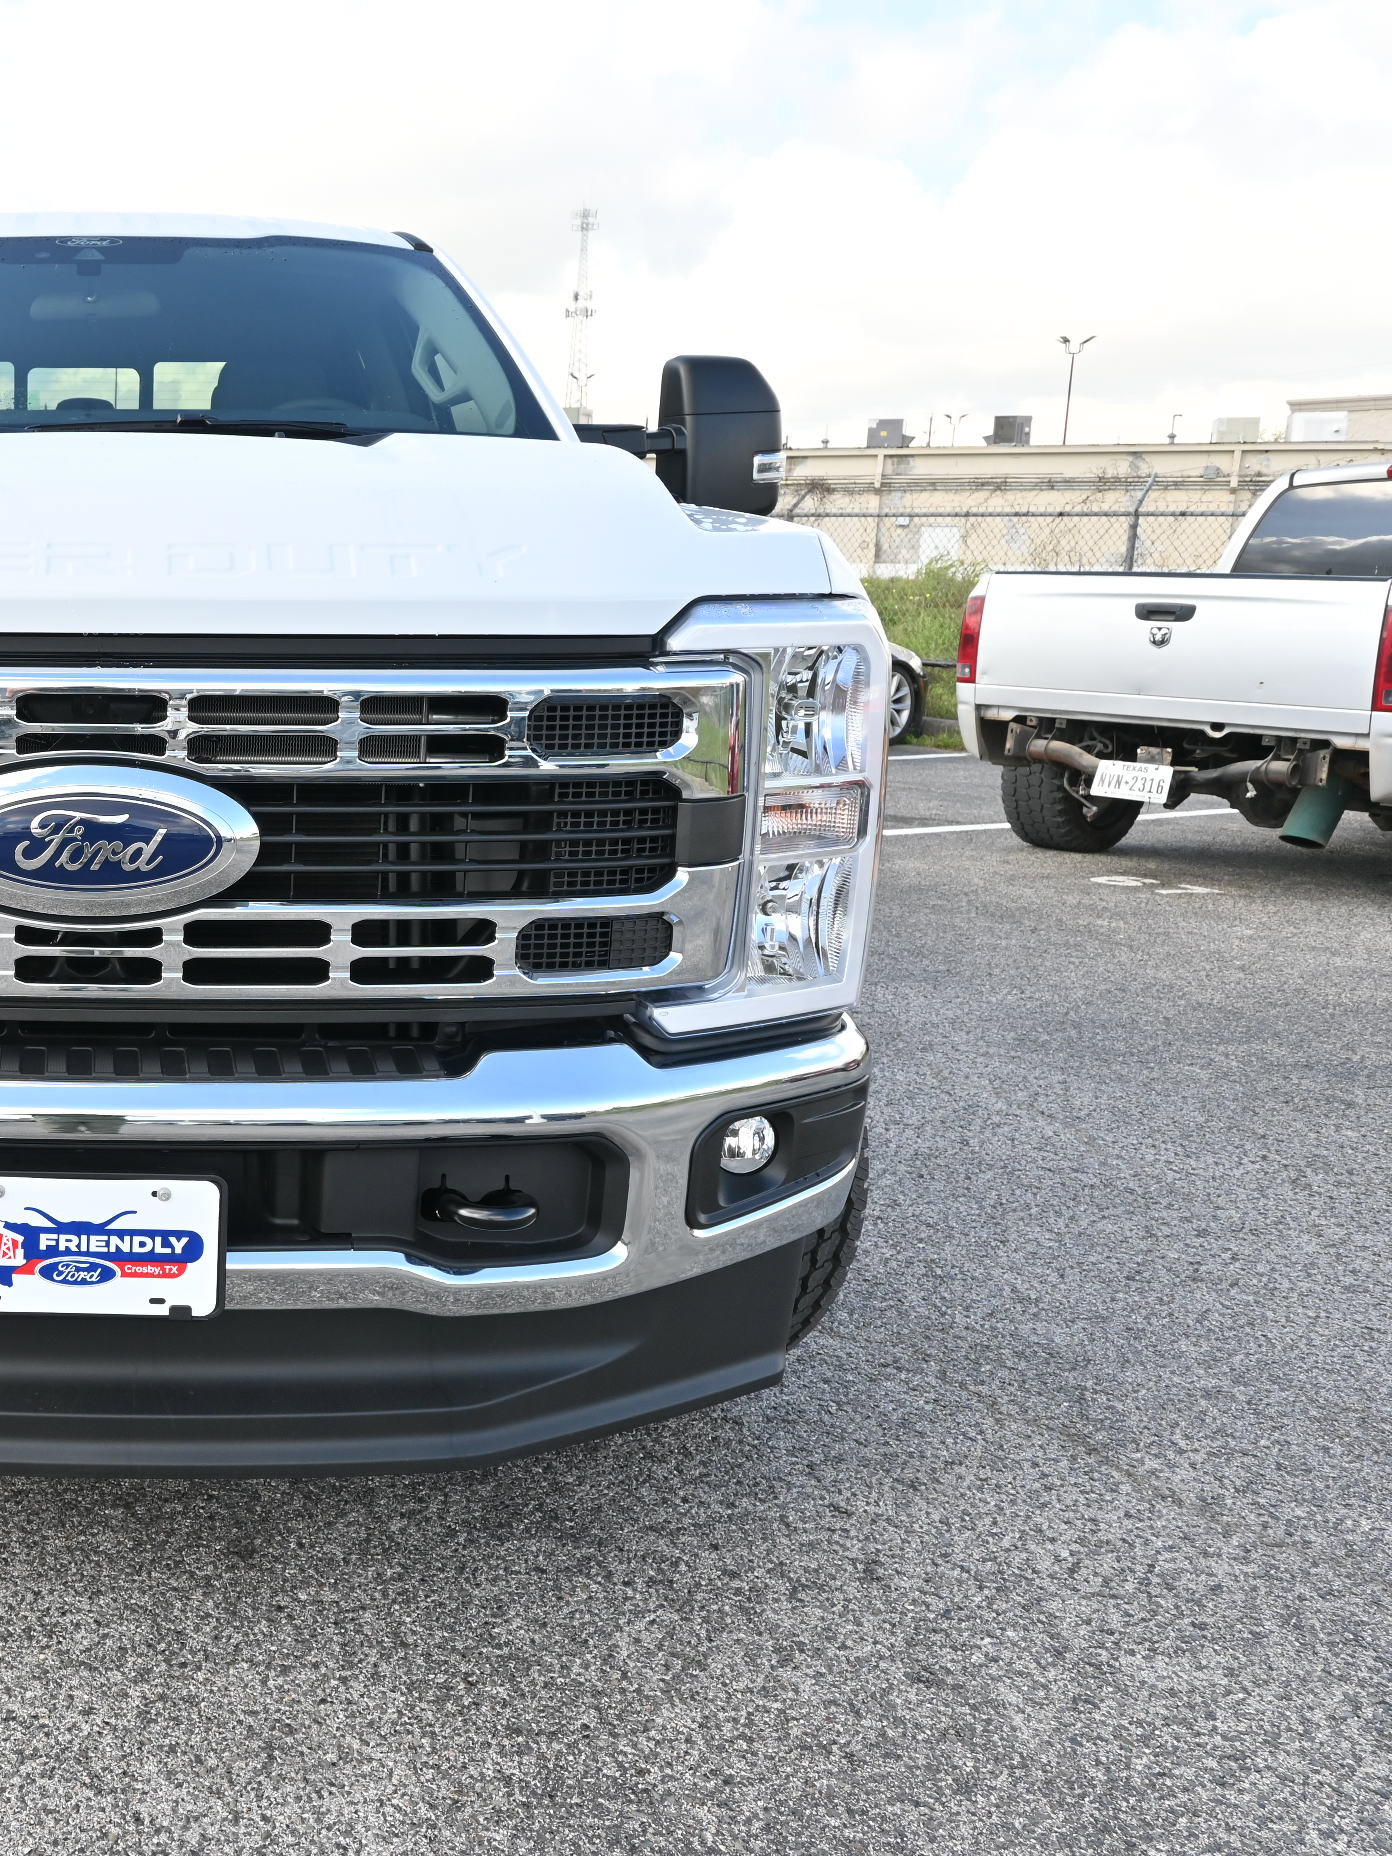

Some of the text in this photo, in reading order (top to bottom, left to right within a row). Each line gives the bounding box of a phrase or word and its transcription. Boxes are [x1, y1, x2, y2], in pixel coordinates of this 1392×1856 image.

[1122, 764, 1149, 773] TEXAS
[14, 809, 168, 872] Ford
[39, 1233, 189, 1255] FRIENDLY
[52, 1263, 100, 1283] Ford
[124, 1264, 179, 1275] Crosby, TX
